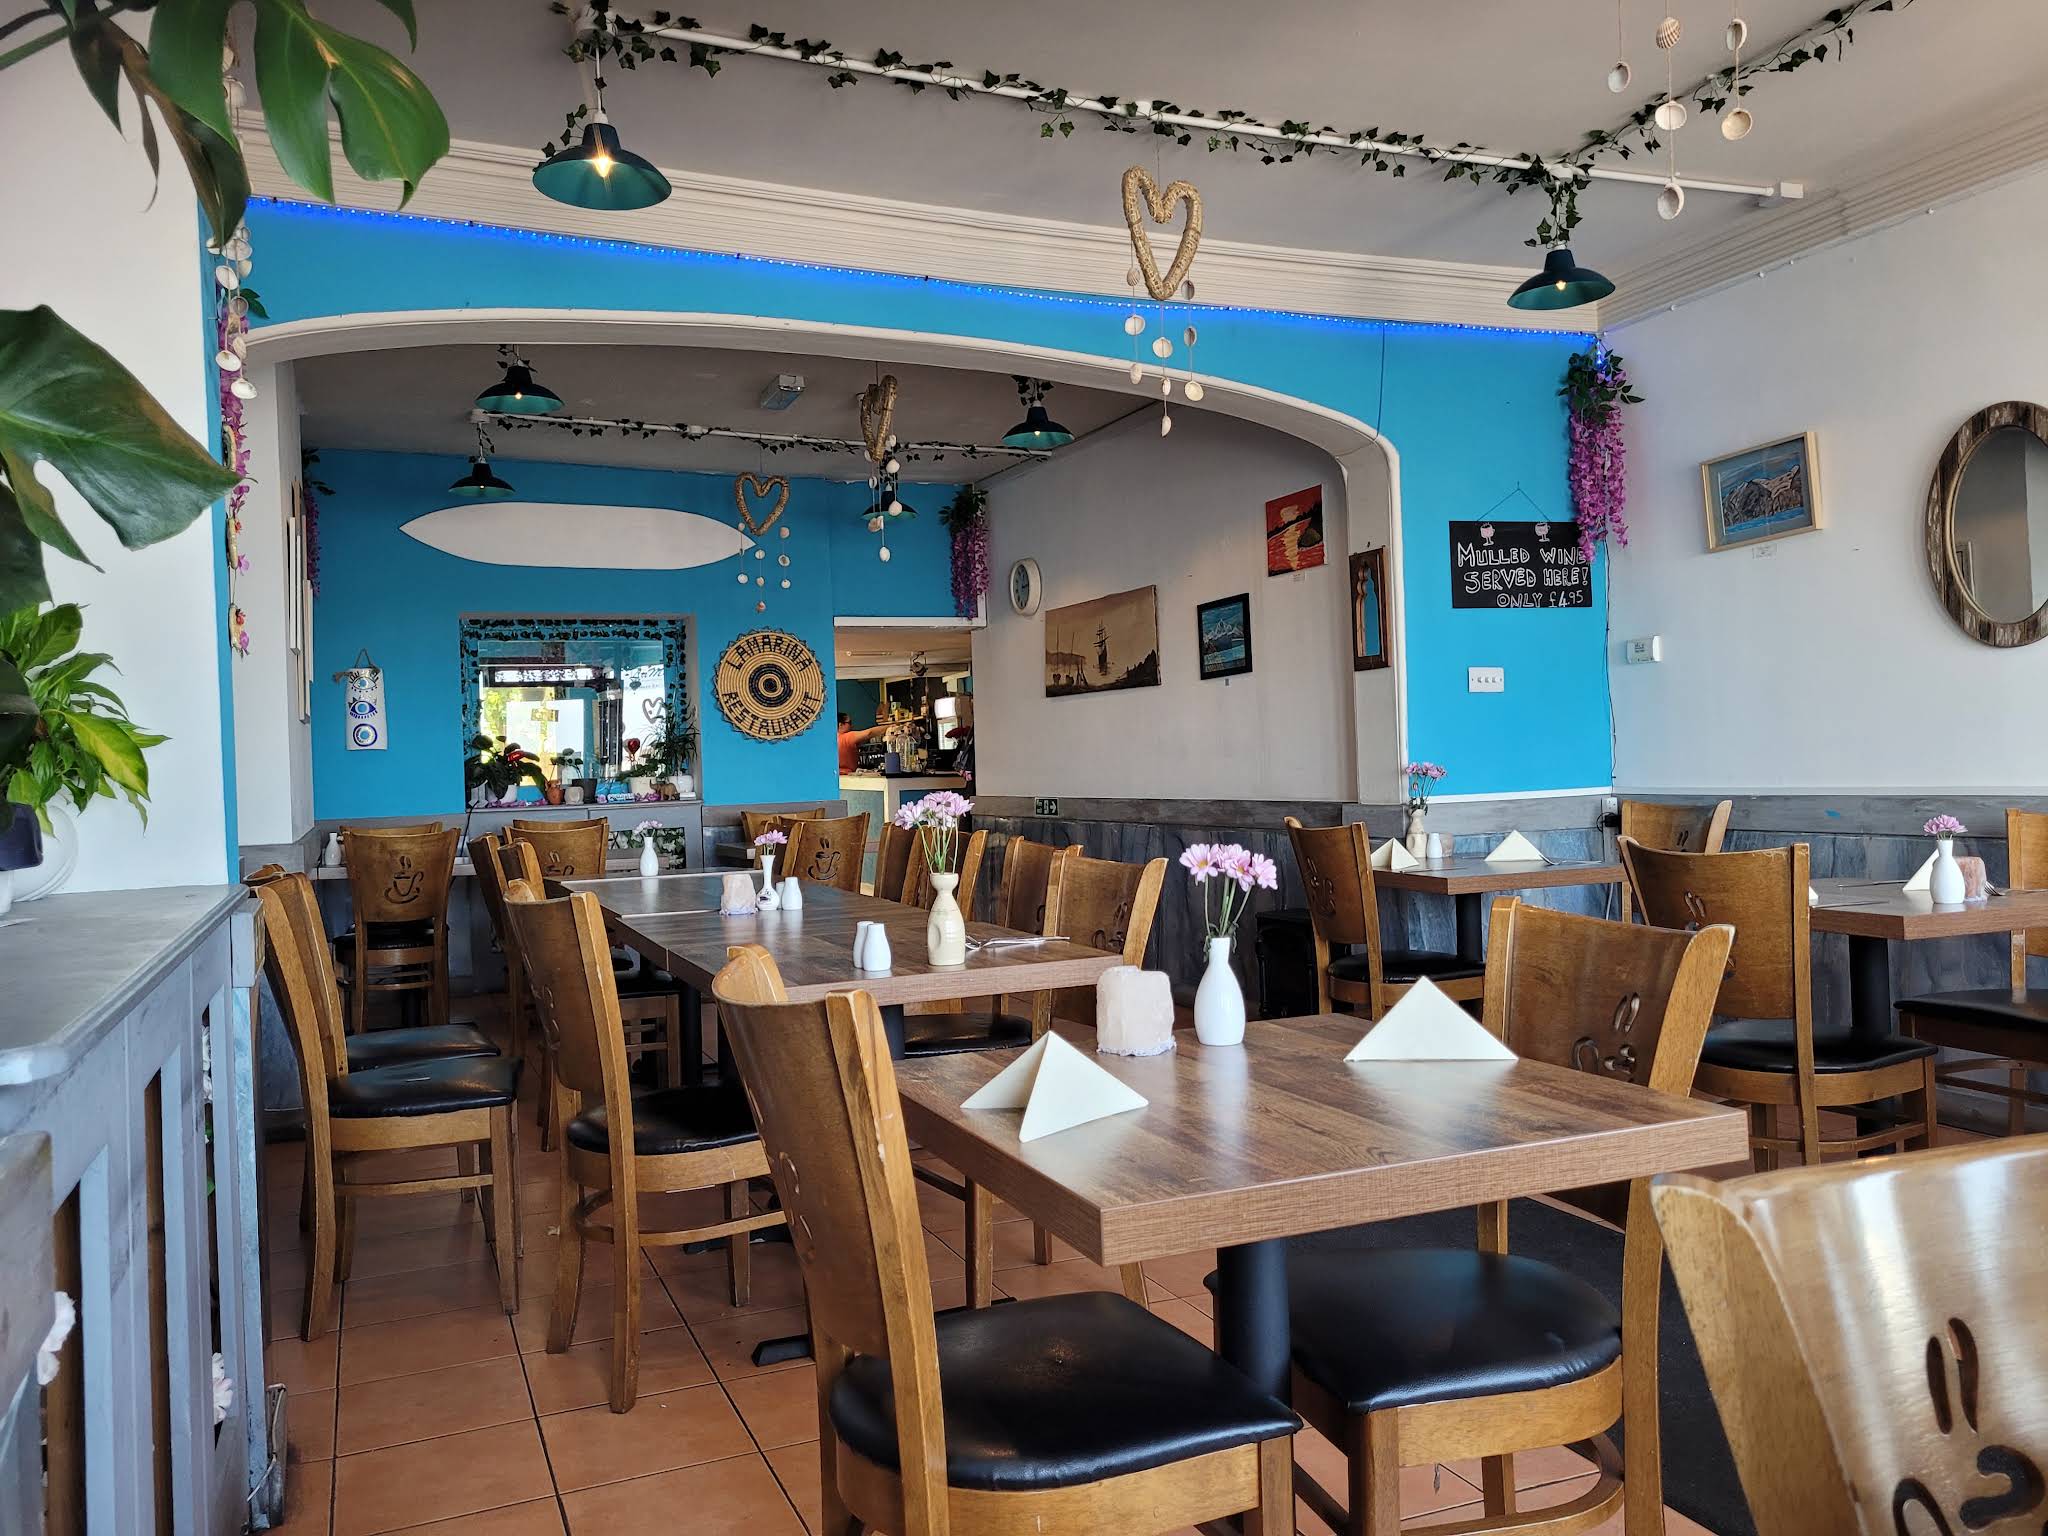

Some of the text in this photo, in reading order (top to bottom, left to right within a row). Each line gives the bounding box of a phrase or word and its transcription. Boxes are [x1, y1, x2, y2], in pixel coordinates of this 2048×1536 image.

[1457, 542, 1530, 568] MULLED
[1463, 567, 1589, 594] SERVED HERE!
[1496, 590, 1584, 608] ONLY £4.95
[722, 691, 821, 736] RESTAURANT
